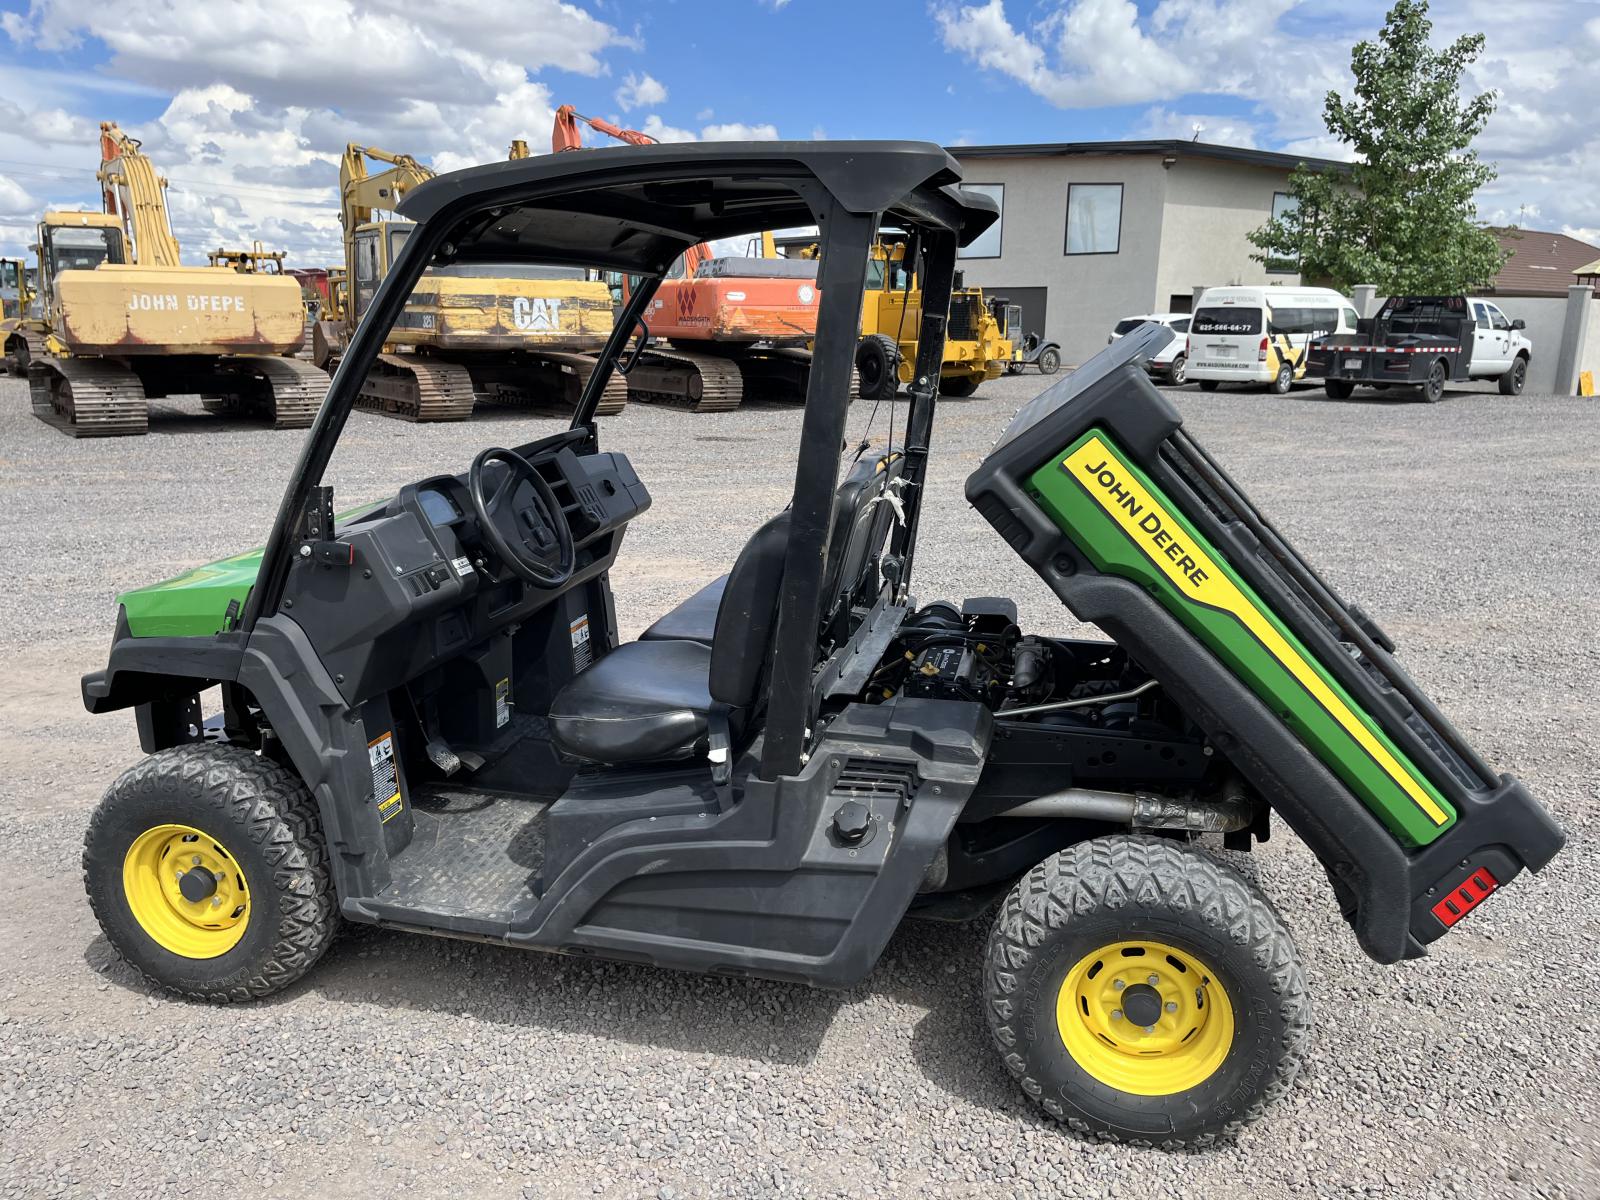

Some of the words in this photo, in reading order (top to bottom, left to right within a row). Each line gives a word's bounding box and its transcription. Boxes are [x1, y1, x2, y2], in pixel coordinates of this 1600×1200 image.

[128, 294, 179, 311] JOHN
[513, 297, 562, 330] CAT
[1084, 460, 1144, 518] JOHN
[1138, 511, 1209, 588] DEERE
